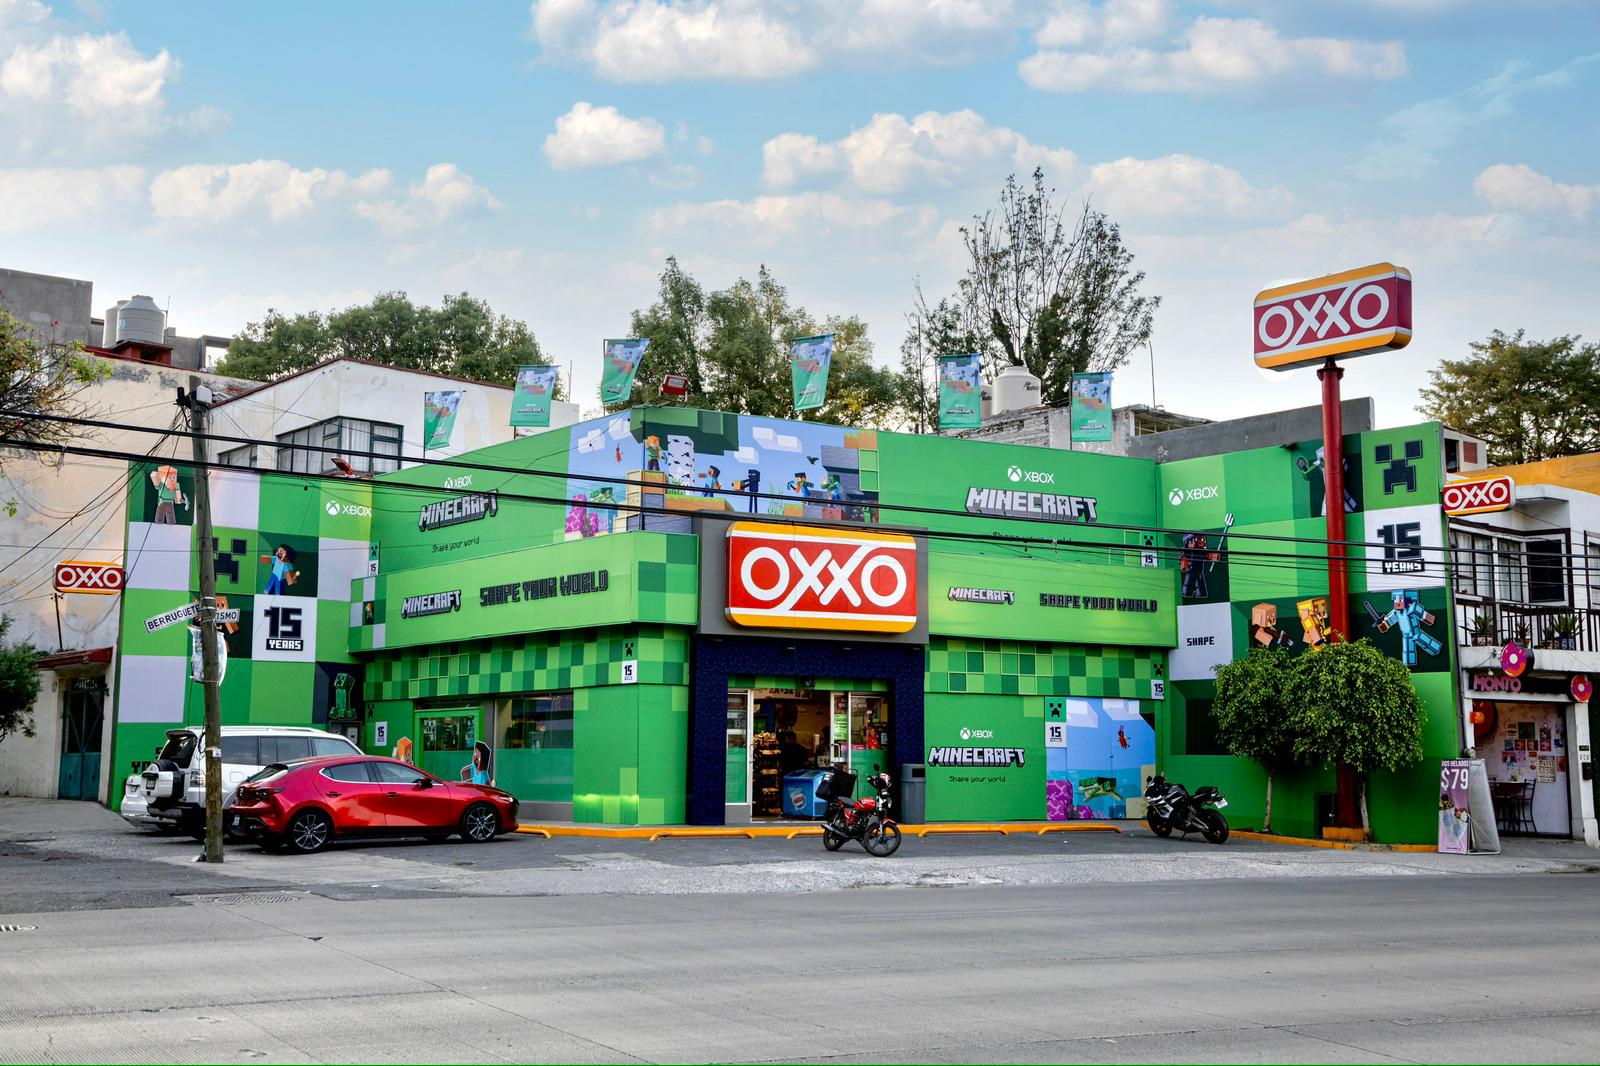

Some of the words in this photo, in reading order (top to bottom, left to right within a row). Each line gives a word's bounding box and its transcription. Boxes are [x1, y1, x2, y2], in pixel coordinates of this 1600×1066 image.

[1259, 285, 1389, 347] OXXO
[454, 474, 472, 489] XBOX
[1023, 471, 1055, 484] XBOX
[1185, 486, 1218, 501] XBOX
[1444, 482, 1508, 509] OXXO
[342, 504, 372, 517] XBOX
[418, 489, 498, 531] MINECRAFT
[965, 486, 1097, 523] MINECRAFT
[1376, 521, 1421, 560] 15
[1385, 561, 1422, 573] YEARS
[57, 567, 122, 589] OXXO
[741, 546, 907, 608] OXXO
[401, 590, 461, 618] MINECRAFT
[480, 582, 521, 606] SHAPE
[522, 577, 557, 601] YOUR
[560, 570, 608, 596] WORLD
[947, 587, 1015, 606] MINECRAFT
[1039, 593, 1080, 609] SHAPE
[1081, 597, 1115, 611] YOUR
[1116, 598, 1157, 613] WORLD
[147, 604, 202, 630] BERRUGUETE
[217, 611, 237, 620] ISMO
[264, 606, 302, 639] 15
[268, 639, 303, 651] YEARS
[1187, 636, 1215, 646] SHAPE
[624, 665, 632, 676] 15
[1154, 683, 1163, 692] 15
[377, 726, 385, 737] 15
[971, 730, 993, 739] XBOX
[1049, 726, 1061, 738] 15
[928, 747, 1025, 767] MINECRAFT
[1441, 768, 1469, 790] $79
